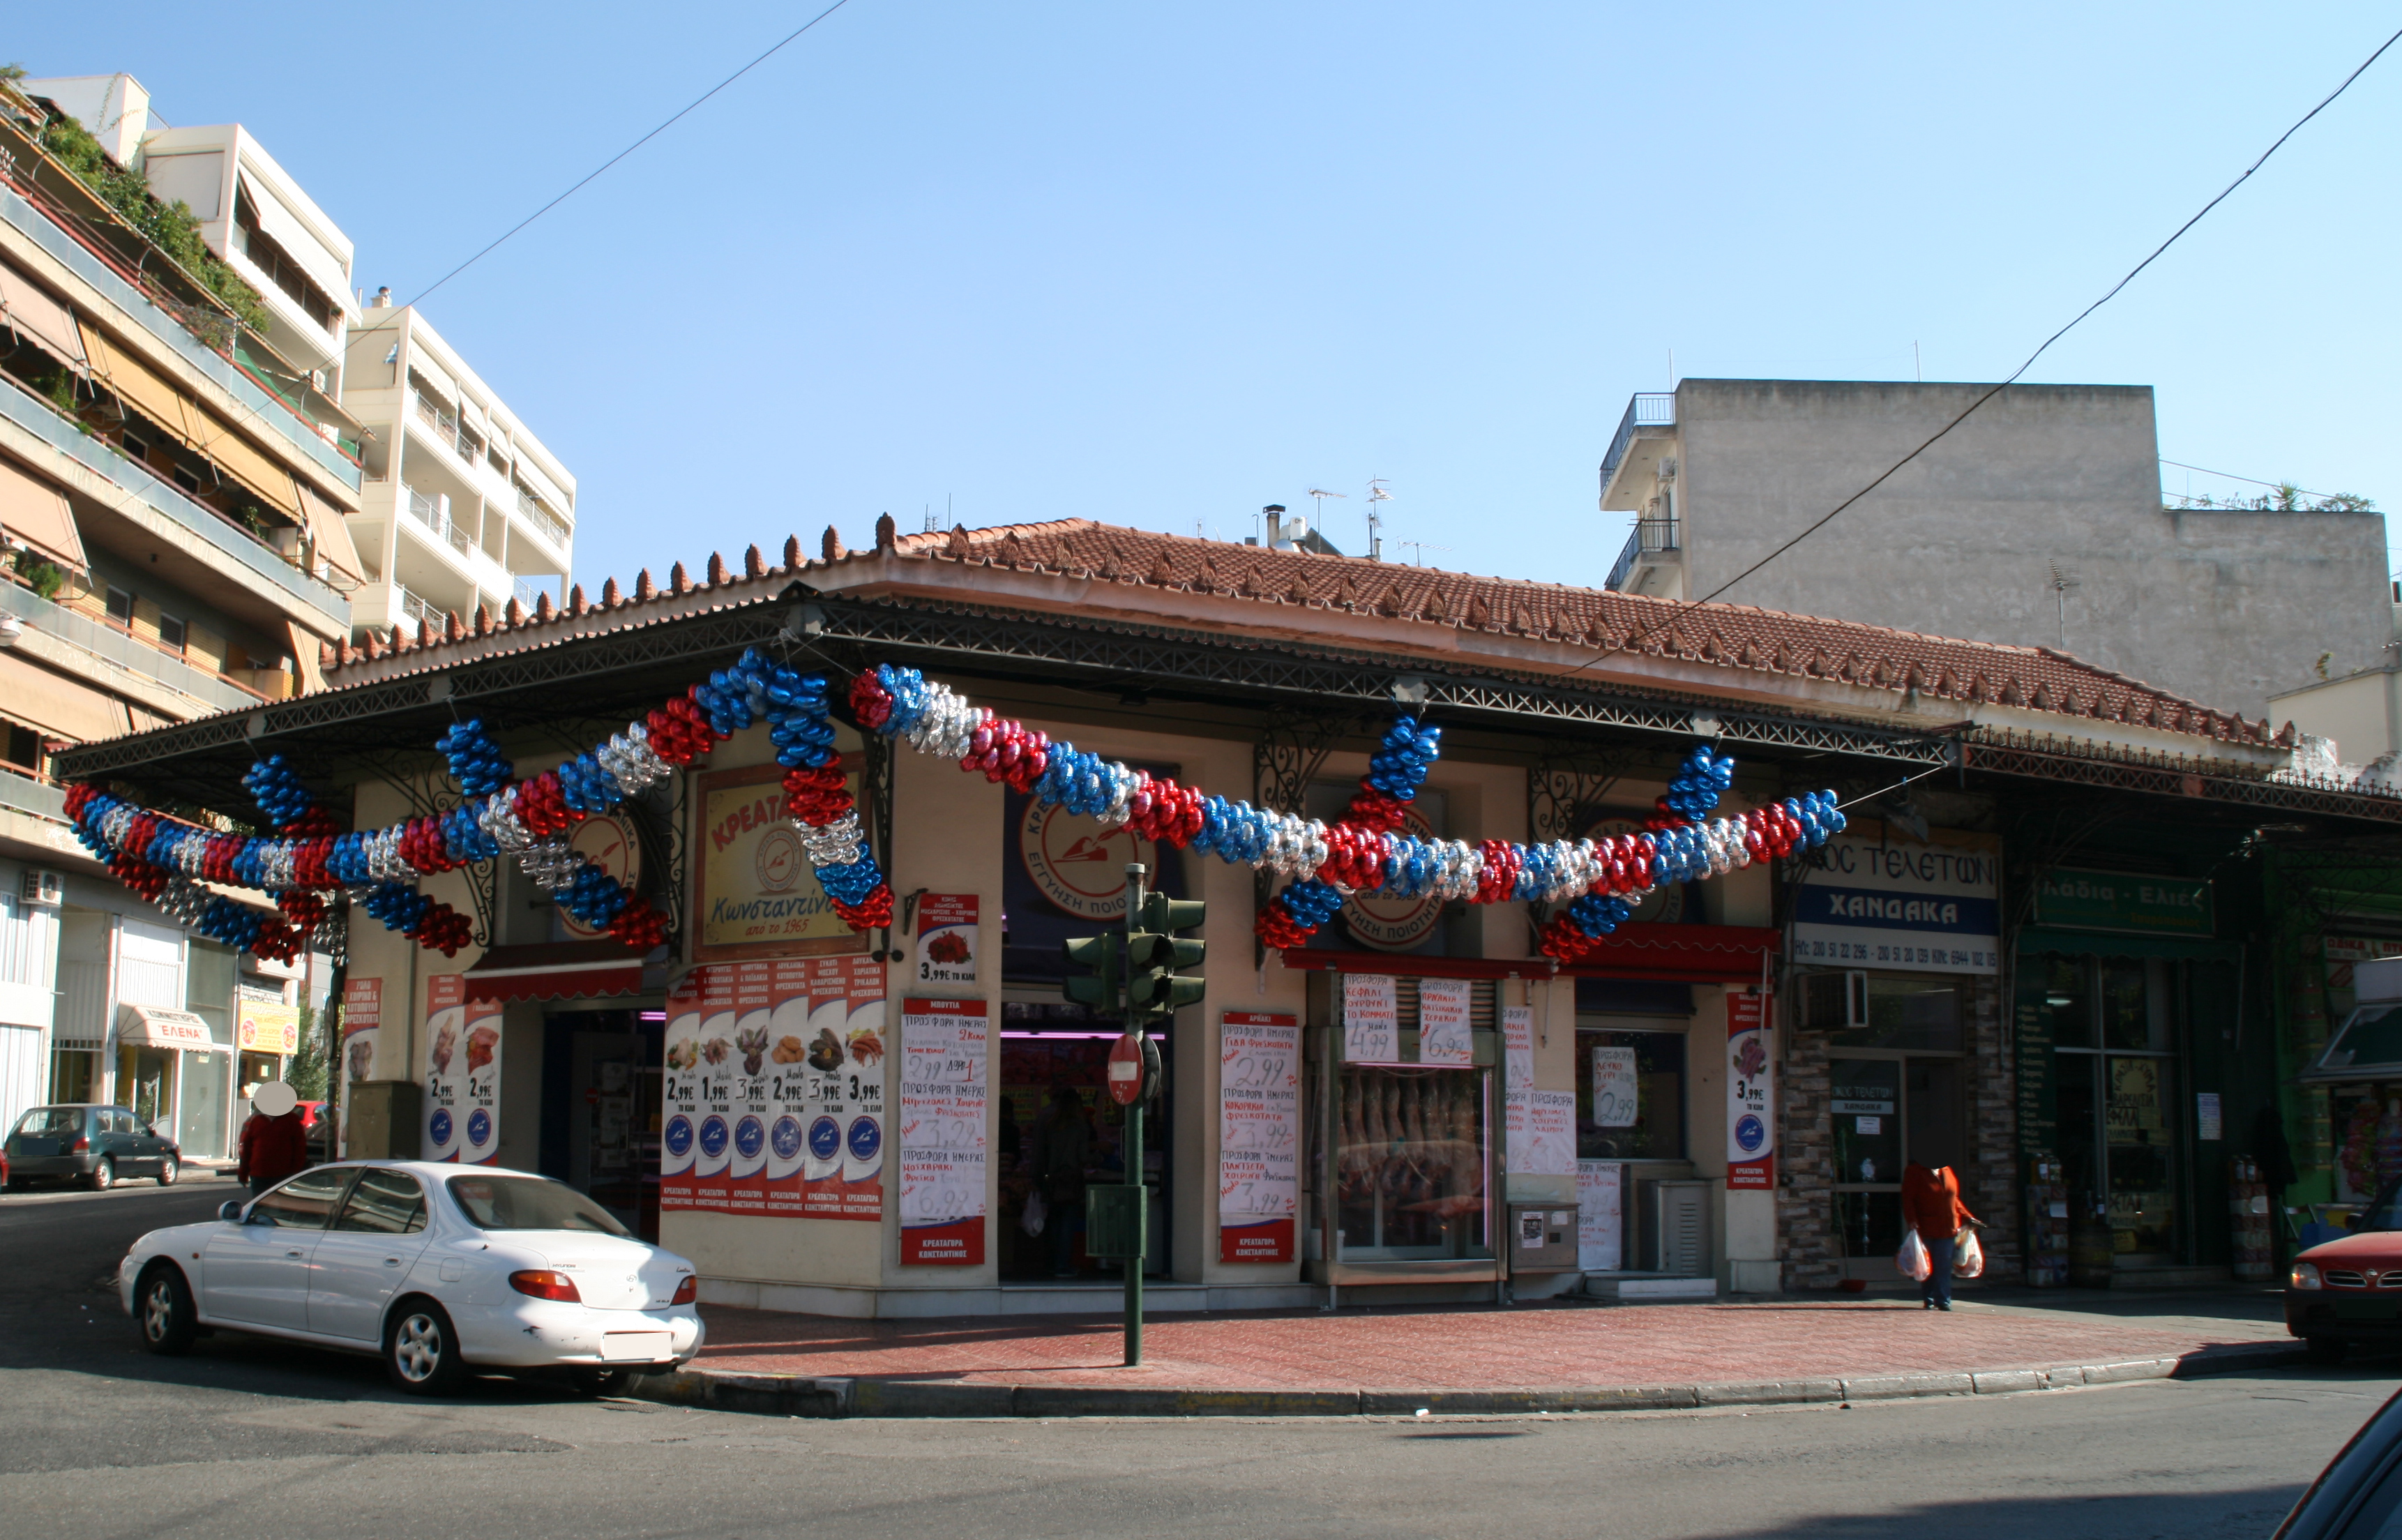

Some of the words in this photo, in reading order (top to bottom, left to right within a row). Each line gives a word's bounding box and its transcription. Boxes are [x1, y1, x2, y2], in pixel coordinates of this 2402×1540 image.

[1029, 852, 1083, 909] ΕΓΓΥΗΣΗ
[2139, 886, 2204, 912] Ελιές
[1829, 893, 1958, 924] ΧΑΝΔΑΚΑ
[1387, 895, 1441, 938] ΠΟΙΟΤΗΤΑ
[745, 921, 766, 936] από
[769, 924, 780, 933] το
[783, 919, 810, 933] 1965
[1813, 942, 1825, 956] 210
[1829, 943, 1836, 957] 51
[1841, 943, 1850, 958] 22
[1854, 944, 1867, 960] 296
[1878, 946, 1889, 961] 210
[1894, 947, 1901, 961] 51
[1904, 947, 1914, 962] 20
[1918, 949, 1928, 964] 139
[1951, 951, 1968, 965] 6944
[1972, 951, 1984, 966] 102
[1988, 953, 1996, 967] 115
[777, 961, 805, 969] ΛΟΥΚΑΝΙΚΑ
[852, 957, 875, 965] ΛΟΥΚΑΝ
[854, 967, 881, 976] ΧΩΡΙΑΤΙΚΑ
[921, 962, 950, 981] 3,99€
[775, 981, 806, 990] ΦΡΕΣΚΟΤΑΤΑ
[854, 978, 879, 986] ΤΡΙΚΑΛΩΝ
[1345, 975, 1387, 986] ΠΡΟΣΦΟΡΑ
[812, 987, 844, 995] ΦΡΕΣΚΟΤΑΤΟ
[850, 988, 883, 997] ΦΡΕΣΚΟΤΑΤΑ
[1345, 987, 1381, 997] ΚΕΦΑΛΙ
[1421, 982, 1463, 992] ΠΡΟΣΦΟΡΑ
[349, 991, 371, 1001] ΧΟΙΡΙΝΟ
[703, 997, 732, 1006] ΦΡΕΣΚΟΤΑΤΑ
[739, 996, 769, 1004] ΦΡΕΣΚΟΤΑΤΑ
[1422, 992, 1456, 1002] ΑΡΝΑΚΙΑ
[345, 1013, 379, 1024] ΦΡΕΣΚΟΤΑΤΑ
[1360, 1010, 1393, 1019] ΚΟΜΜΑΤΙ
[906, 1016, 954, 1027] ΠΡΟΣΦΟΡΑ
[959, 1019, 986, 1028] ΗΜΕΡΑΣ
[959, 1029, 967, 1041] 2
[1224, 1025, 1262, 1037] ΠΡΟΣΦΟΡΑ
[1267, 1028, 1294, 1039] ΗΜΕΡΑΣ
[1225, 1036, 1245, 1047] ΓΙΔΑ
[1350, 1020, 1388, 1057] 4,99
[1236, 1057, 1284, 1086] 2,99
[432, 1078, 453, 1099] 2,99€
[469, 1077, 491, 1099] 2,99€
[667, 1077, 694, 1103] 2,99€
[702, 1076, 728, 1103] 1,99€
[736, 1078, 764, 1103] 3,99€
[773, 1075, 802, 1103] 2,99€
[809, 1078, 840, 1102] 3,99€
[849, 1075, 880, 1103] 3,99€
[903, 1083, 951, 1095] ΠΡΟΣΦΟΡΑ
[955, 1085, 985, 1098] ΗΜΕΡΑΣ
[1737, 1080, 1763, 1101] 3,99€
[1224, 1089, 1262, 1099] ΠΡΟΣΦΟΡΑ
[1267, 1089, 1294, 1100] ΗΜΕΡΑΣ
[1532, 1093, 1573, 1106] ΠΡΟΣΦΟΡΑ
[1599, 1092, 1633, 1122] 2,99
[1226, 1112, 1283, 1121] ΦΡΕΣΚΟΤΑΤΑ
[1235, 1123, 1287, 1148] 3,99
[904, 1151, 947, 1162] ΠΡΟΣΦΟΡΑ
[953, 1153, 985, 1163] ΗΜΕΡΑΣ
[1222, 1151, 1261, 1161] ΠΡΟΣΦΟΡΑ
[1222, 1162, 1264, 1171] ΠΑΝΤΣΕΤΑ
[664, 1187, 692, 1195] ΚΡΕΑΤΑΓΟΡΑ
[698, 1188, 727, 1197] ΚΡΕΑΤΑΓΟΡΑ
[734, 1190, 763, 1198] ΚΡΕΑΤΑΓΟΡΑ
[770, 1191, 801, 1200] ΚΡΕΑΤΑΓΟΡΑ
[661, 1197, 693, 1205] ΚΩΝΣΤΑΝΤΙΝΟΣ
[808, 1193, 839, 1201] ΚΡΕΑΤΑΓΟΡΑ
[847, 1194, 879, 1202] ΚΡΕΑΤΑΓΟΡΑ
[919, 1186, 969, 1214] 6,99
[1238, 1182, 1279, 1212] 3,99
[695, 1199, 730, 1207] ΚΩΝΣΤΑΝΤΙΝΟΣ
[731, 1200, 765, 1209] ΚΩΝΣΤΑΝΤΙΝΟΣ
[768, 1202, 803, 1211] ΚΩΝΣΤΑΝΤΙΝΟΣ
[805, 1203, 842, 1212] ΚΩΝΣΤΑΝΤΙΝΟΣ
[843, 1205, 882, 1214] ΚΩΝΣΤΑΝΤΙΝΟΣ
